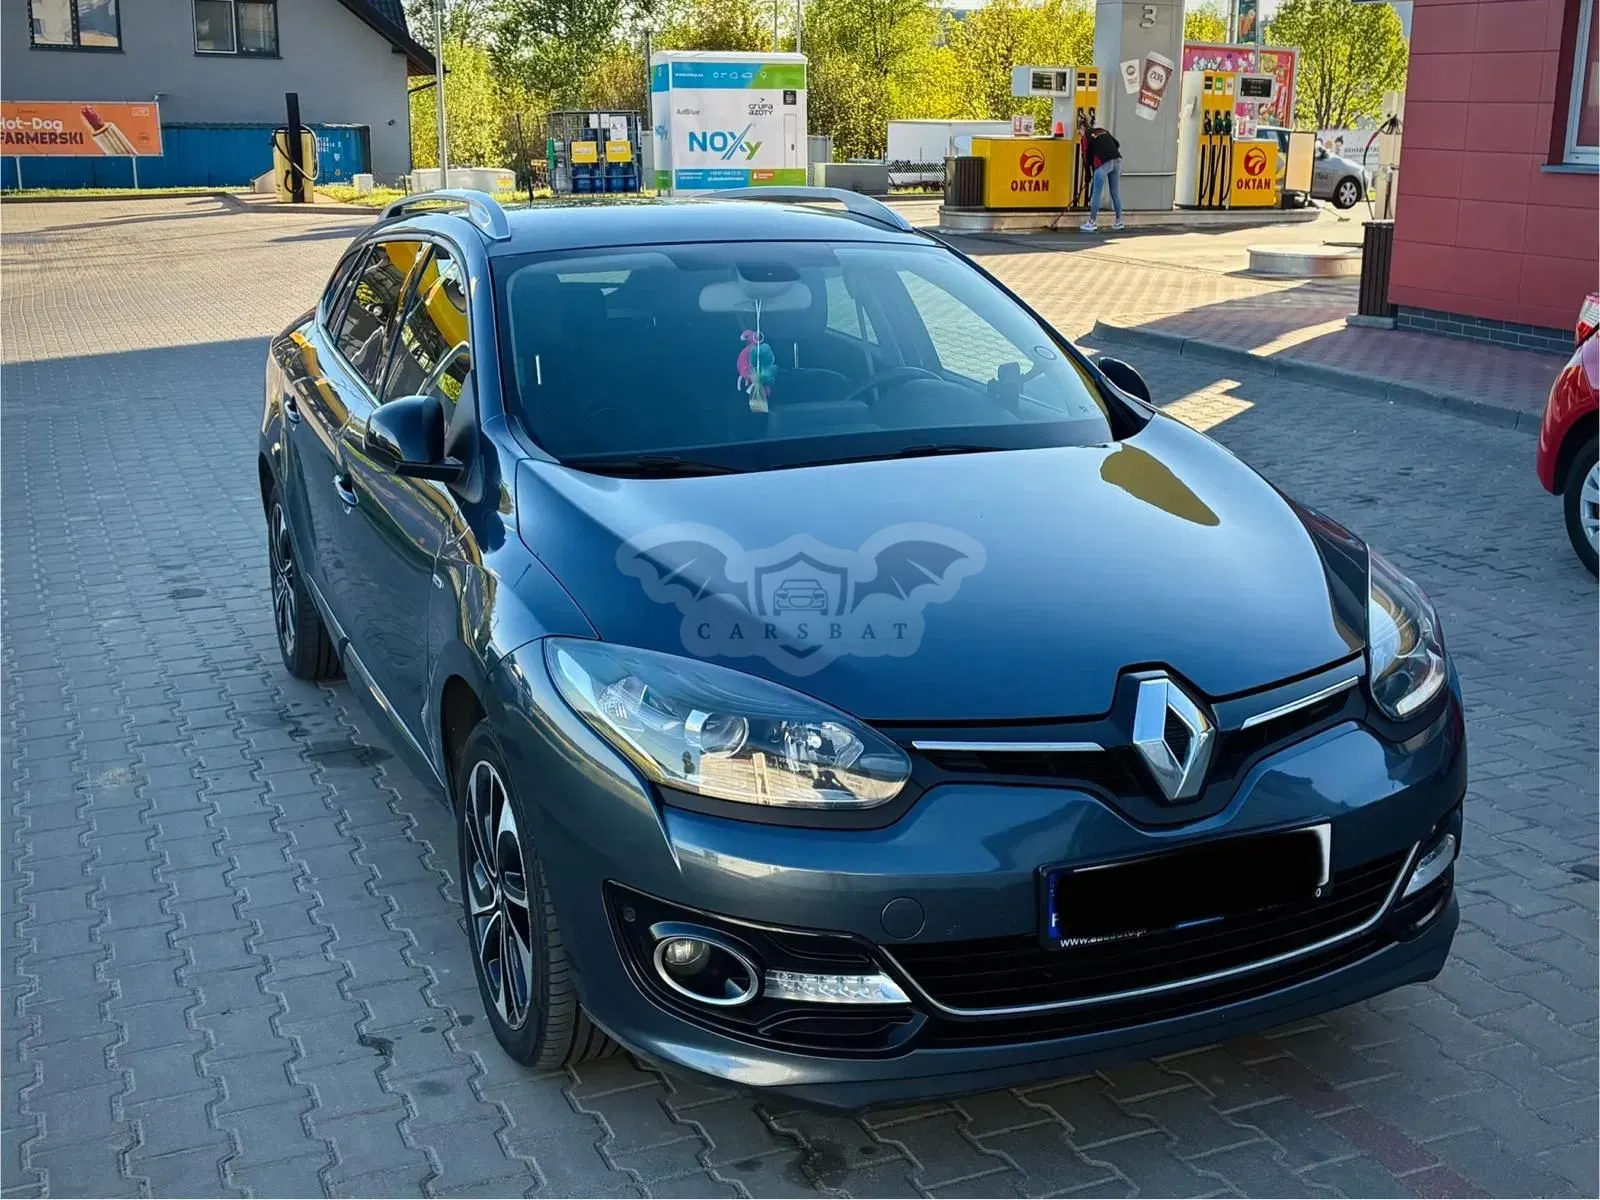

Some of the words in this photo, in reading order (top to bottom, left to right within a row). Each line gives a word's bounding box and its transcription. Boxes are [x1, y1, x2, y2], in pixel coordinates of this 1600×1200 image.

[1139, 4, 1157, 28] 3
[688, 123, 763, 160] NOXy
[1011, 179, 1049, 192] OKTAN
[1236, 178, 1271, 190] OKTAN
